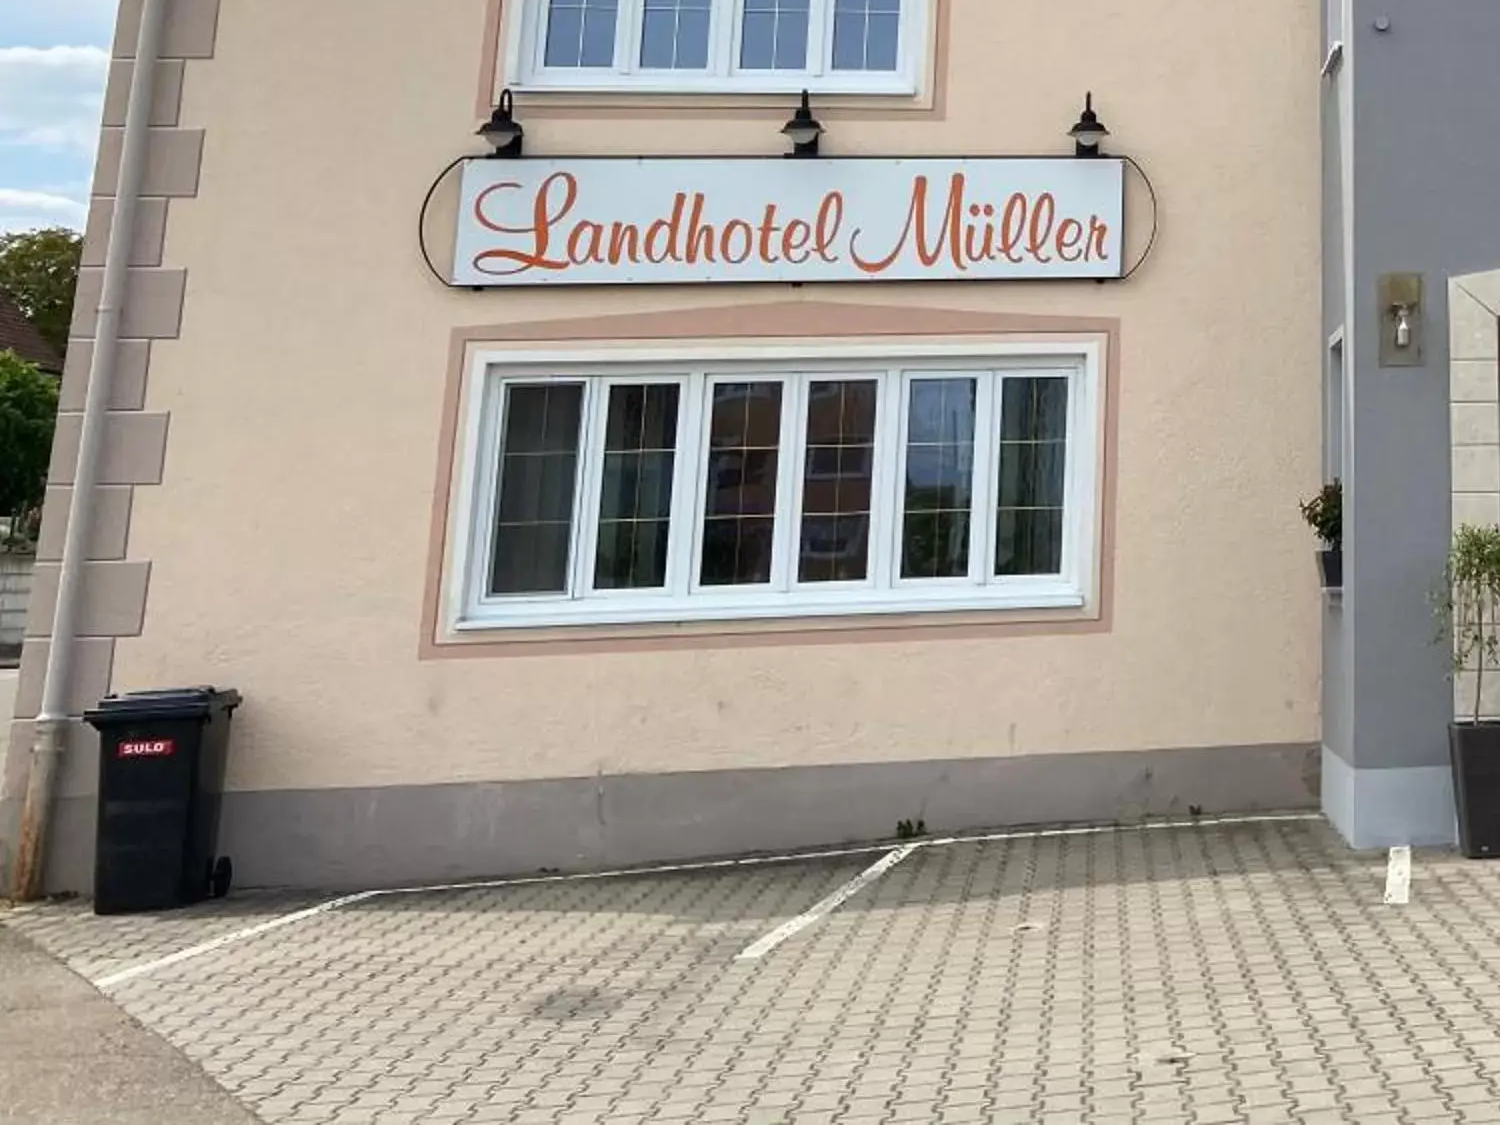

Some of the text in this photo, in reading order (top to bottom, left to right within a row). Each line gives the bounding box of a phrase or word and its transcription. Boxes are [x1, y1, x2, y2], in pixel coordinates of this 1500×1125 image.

[473, 172, 1108, 275] Landhotel Müller
[123, 742, 165, 754] SULO
